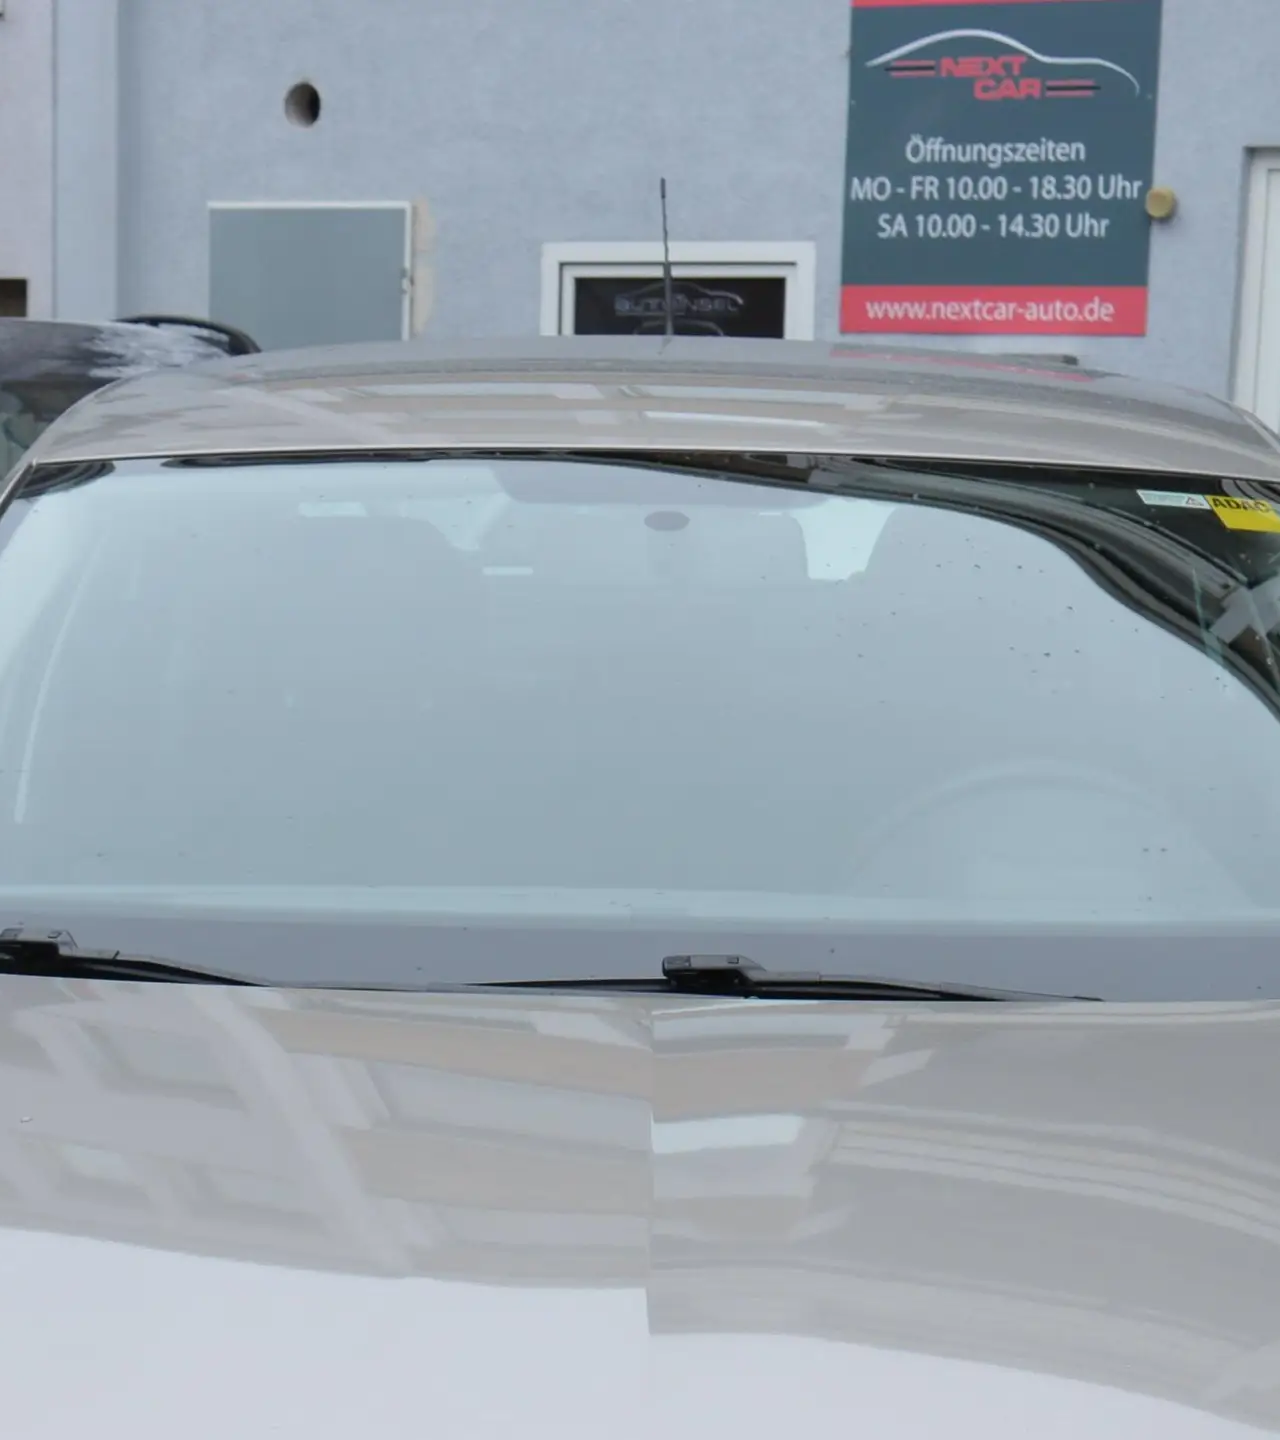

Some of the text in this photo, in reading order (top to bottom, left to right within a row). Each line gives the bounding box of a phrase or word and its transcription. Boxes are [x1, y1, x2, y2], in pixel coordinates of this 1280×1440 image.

[940, 56, 1026, 77] NEXT
[973, 79, 1041, 100] CAR
[905, 134, 1086, 168] Öffnungszeiten
[850, 177, 890, 200] MO
[911, 176, 939, 200] FR
[947, 176, 1008, 200] 10.00
[1029, 175, 1091, 200] 18.30
[1098, 174, 1143, 199] Uhr
[877, 214, 908, 238] SA
[915, 214, 976, 238] 10.00
[998, 214, 1060, 238] 14.30
[1065, 213, 1110, 238] Uhr
[865, 297, 1115, 322] www.nextcar-auto.de
